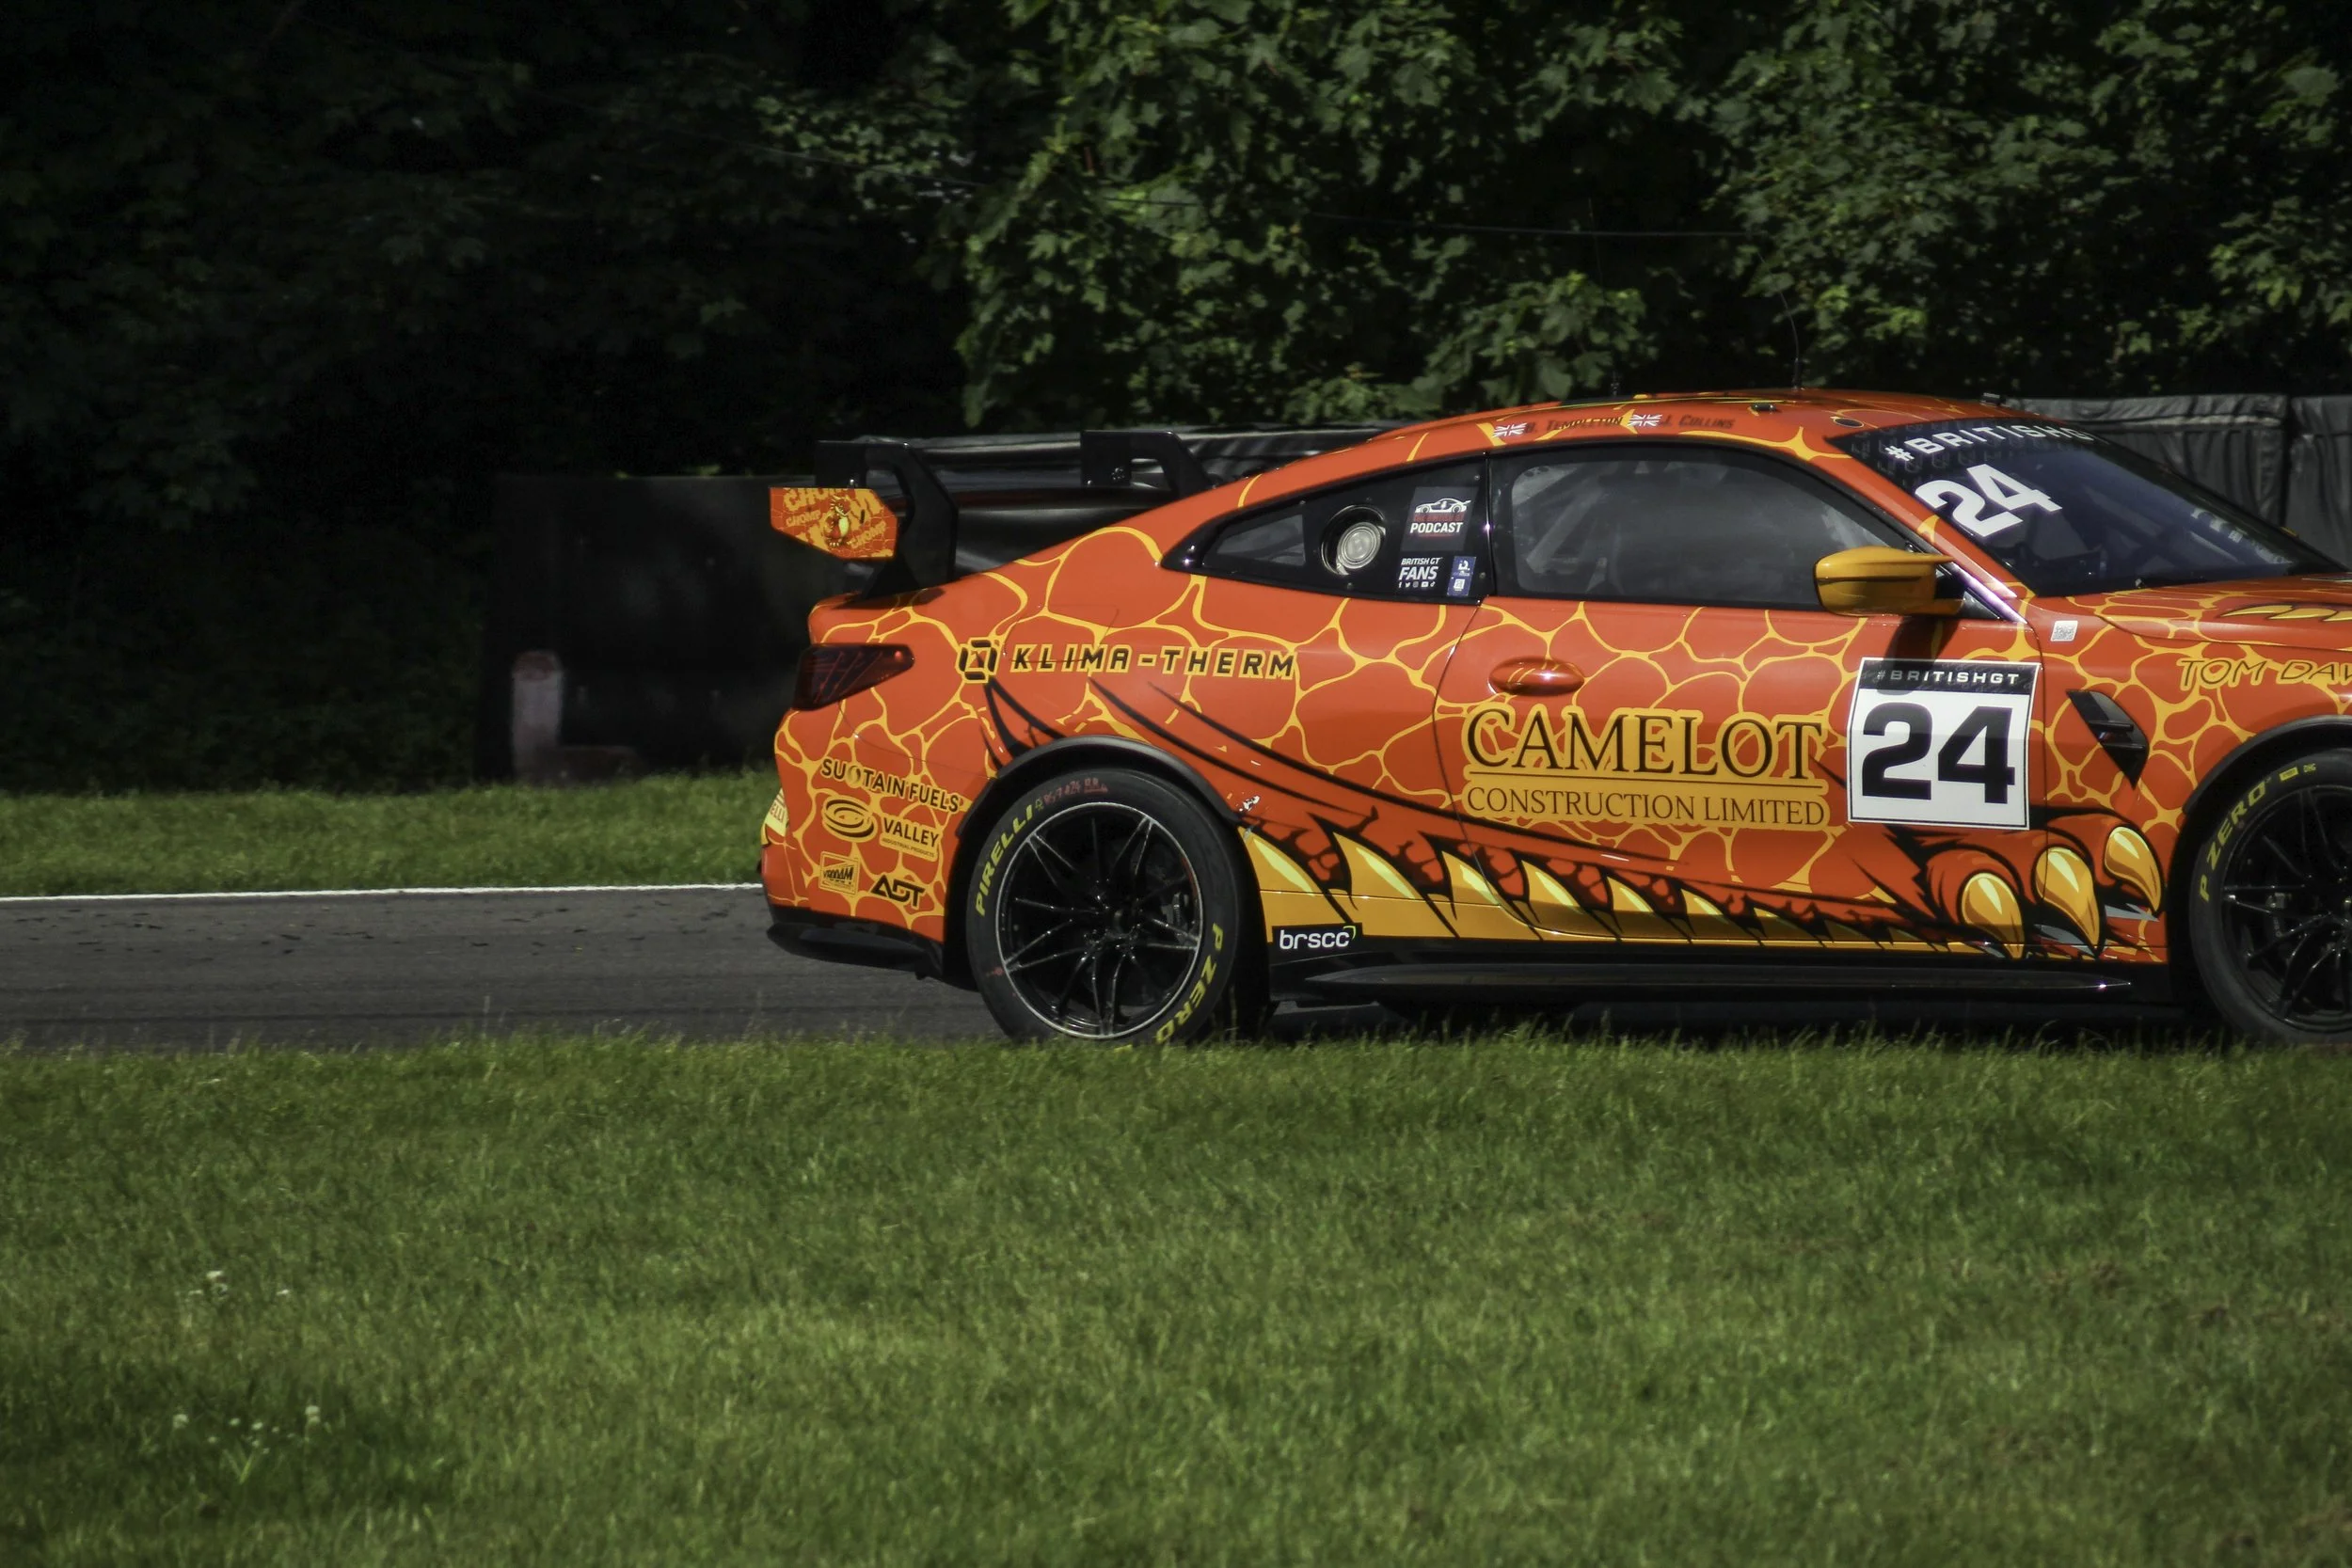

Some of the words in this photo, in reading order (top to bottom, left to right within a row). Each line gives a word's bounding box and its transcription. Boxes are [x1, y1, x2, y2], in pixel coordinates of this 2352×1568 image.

[1678, 414, 1736, 430] COLLINS
[1915, 463, 2063, 537] 24
[1409, 522, 1464, 533] PODCAST
[1399, 566, 1438, 580] FANS
[1012, 646, 1296, 680] KLIMA-THERM
[1876, 669, 2020, 685] #BRITISHGT
[2181, 659, 2268, 687] TOM
[1467, 707, 1823, 780] CAMELOT
[1862, 702, 2015, 804] 24
[909, 784, 959, 812] FUELS
[1467, 786, 1694, 820] CONSTRUCTION
[1704, 797, 1824, 827] LIMITED
[883, 816, 939, 847] VALLEY
[2199, 874, 2210, 902] P
[2206, 779, 2266, 871] ZERO
[975, 803, 1034, 916] PIRELLI
[1212, 923, 1224, 951] P
[1279, 929, 1350, 950] brscc
[1155, 955, 1217, 1044] ZERO
